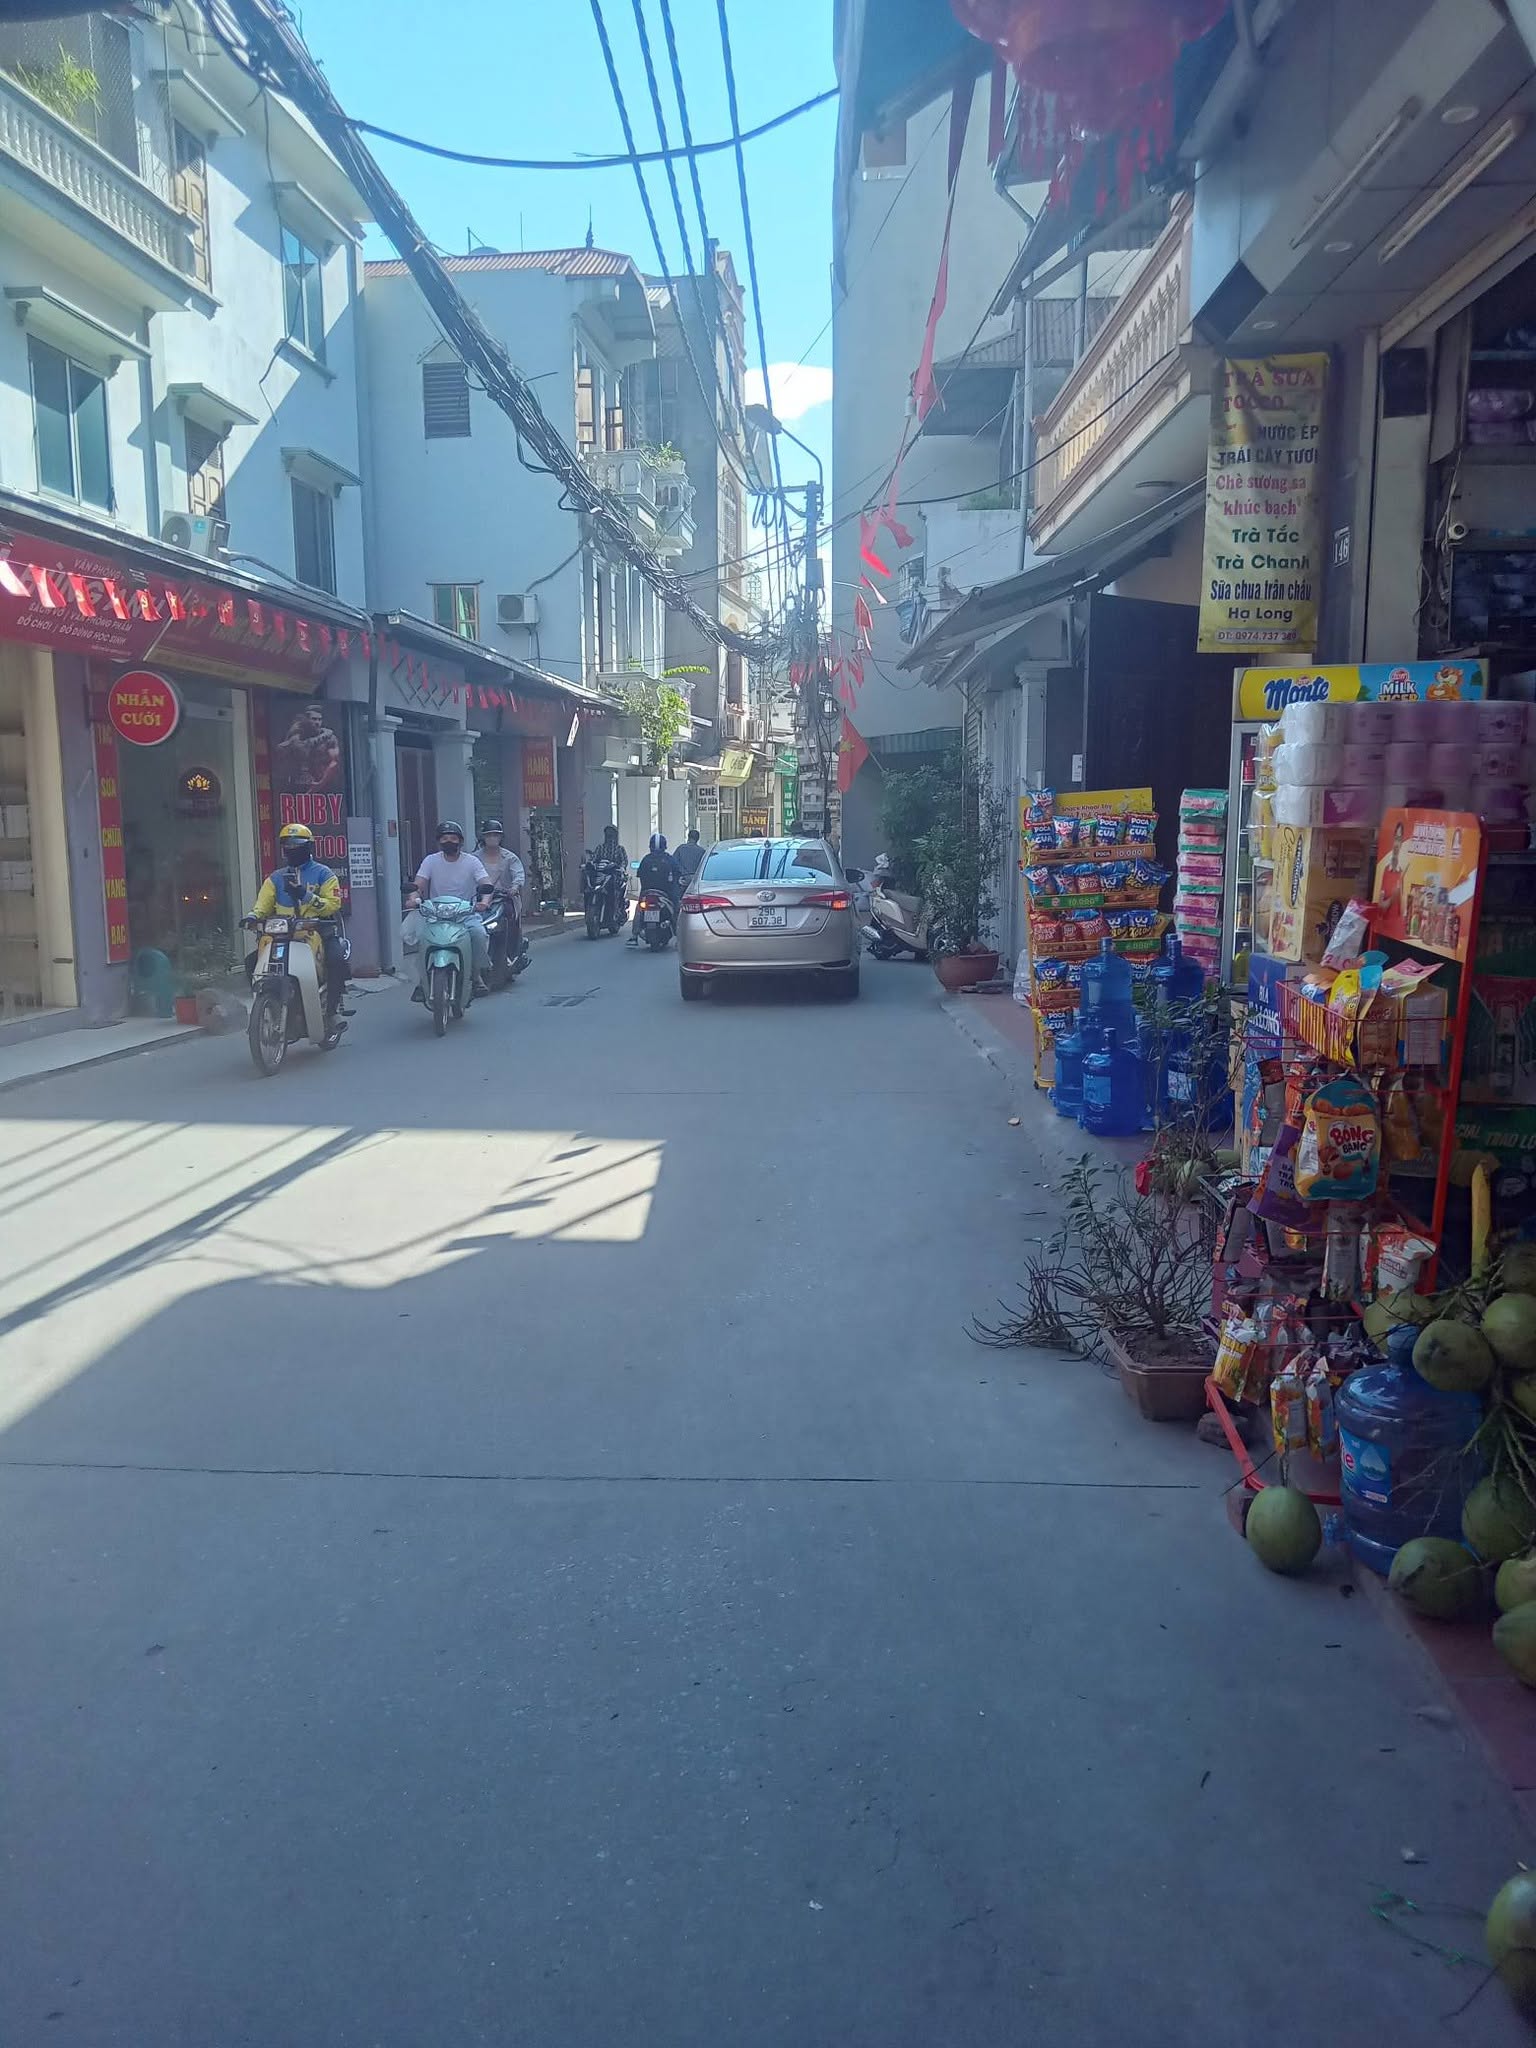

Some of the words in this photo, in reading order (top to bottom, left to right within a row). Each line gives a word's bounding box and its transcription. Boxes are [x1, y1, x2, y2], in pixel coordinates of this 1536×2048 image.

[1300, 423, 1319, 440] ÉP
[1218, 447, 1251, 465] TRÁI
[1255, 445, 1283, 463] CÂY
[1215, 473, 1243, 490] Chè
[1224, 499, 1260, 516] khúc
[1265, 499, 1296, 519] bạch
[1232, 528, 1260, 543] Trà
[1267, 525, 1299, 543] Tắc
[1217, 555, 1244, 569] Trà
[1251, 555, 1310, 569] Chanh
[1210, 579, 1231, 600] Sữa
[1234, 580, 1261, 600] chua
[1228, 607, 1250, 622] Hạ
[1256, 607, 1293, 623] Long
[116, 688, 165, 707] NHẪN
[1264, 676, 1330, 711] Monte
[120, 710, 162, 727] CƯỚI
[699, 785, 717, 796] CHÈ
[279, 793, 344, 825] RUBY
[742, 813, 767, 825] BÁNH
[1099, 818, 1119, 827] POCA
[1131, 817, 1150, 826] POCA
[1034, 825, 1052, 833] POCA
[1097, 828, 1116, 838] CUA
[1129, 827, 1148, 837] CUA
[1034, 835, 1054, 844] CUA
[757, 907, 776, 916] 29D
[751, 917, 783, 926] 607.38
